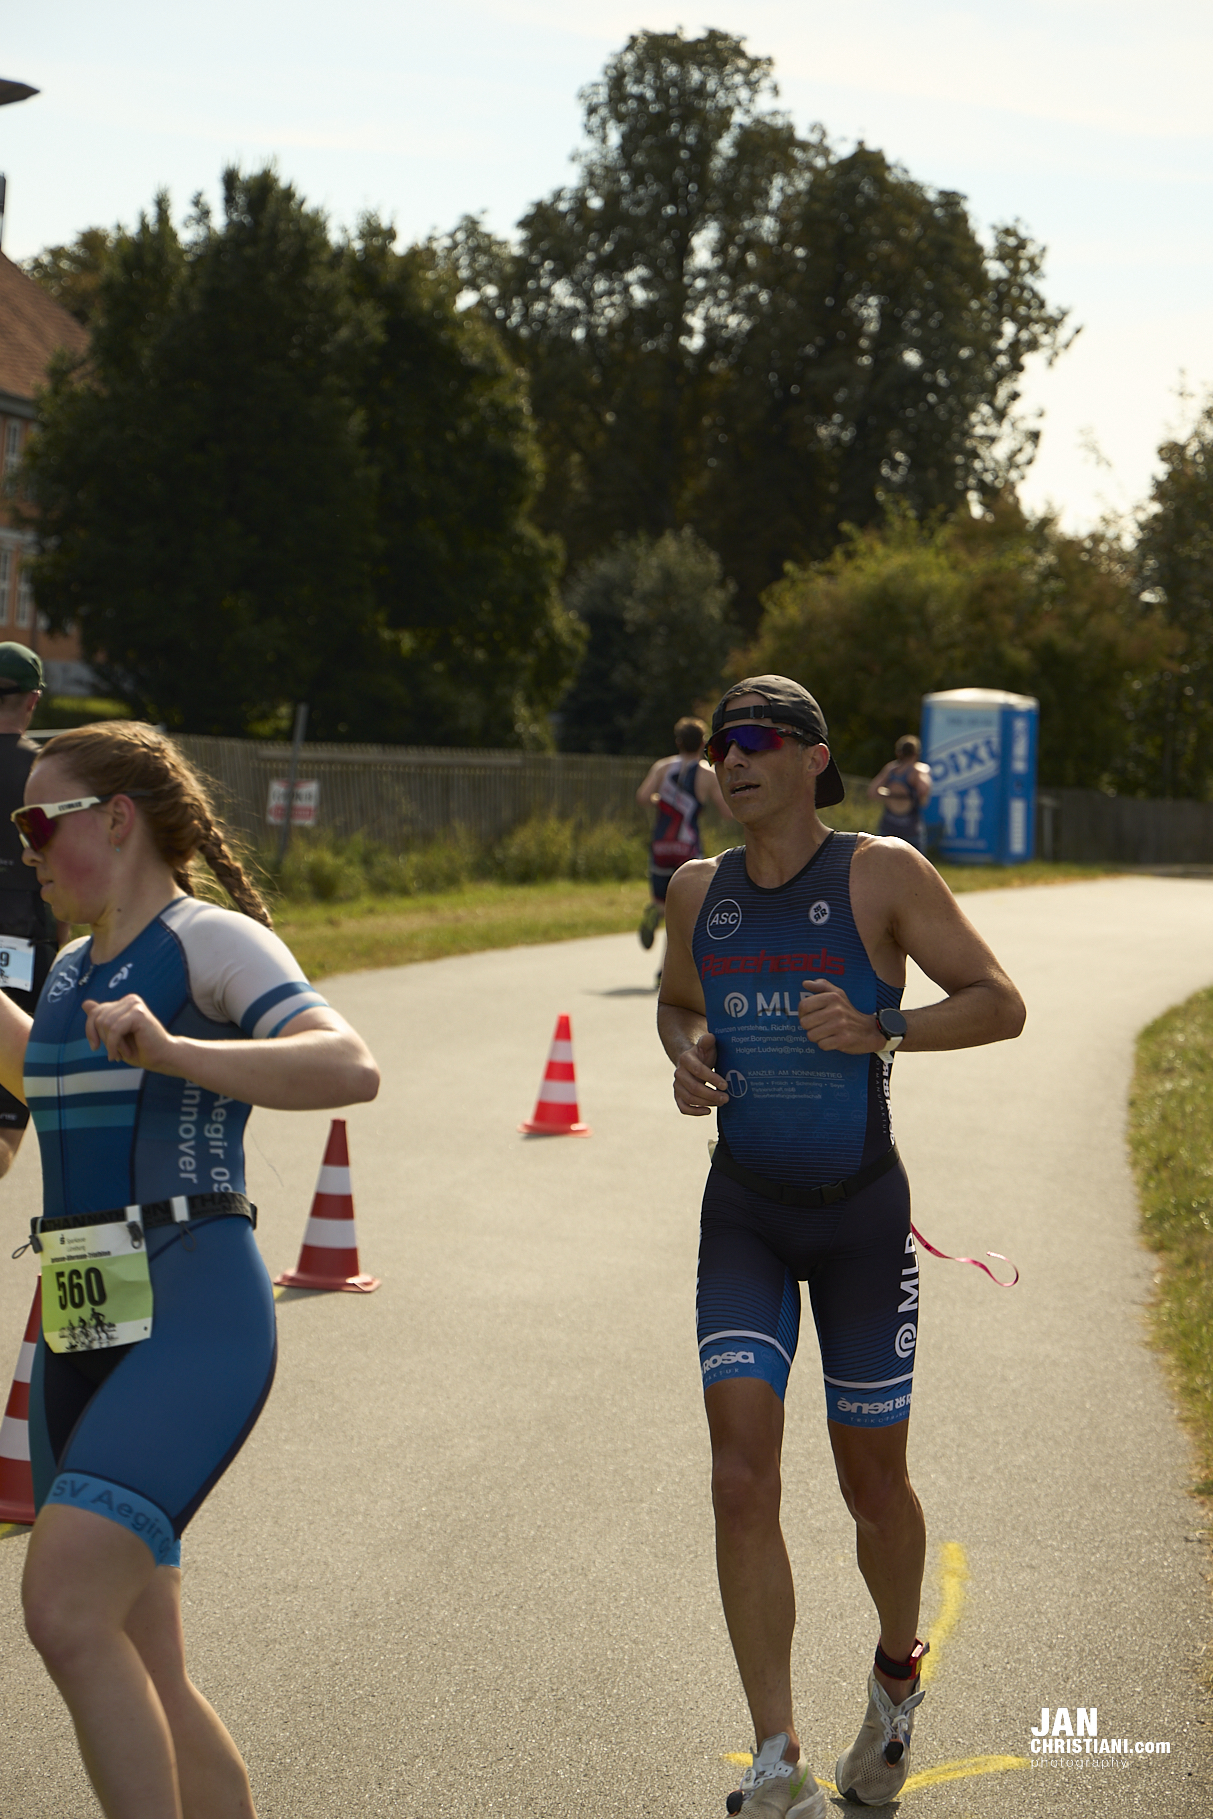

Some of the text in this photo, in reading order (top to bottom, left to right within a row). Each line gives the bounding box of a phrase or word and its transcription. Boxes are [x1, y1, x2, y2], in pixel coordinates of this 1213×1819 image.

[709, 912, 739, 926] ASC
[701, 947, 845, 980] Paceheads
[715, 1025, 737, 1034] Finanzen
[771, 1023, 796, 1032] Richtig
[731, 1034, 809, 1044] Roger.Borgmann@mlp.
[735, 1045, 816, 1055] Holger.Ludwig@mlp.de
[791, 1069, 843, 1079] NONNENSTIEG
[875, 1060, 887, 1134] OTMANUFAKTUR
[54, 1266, 108, 1311] 560
[90, 1488, 163, 1539] Aegir
